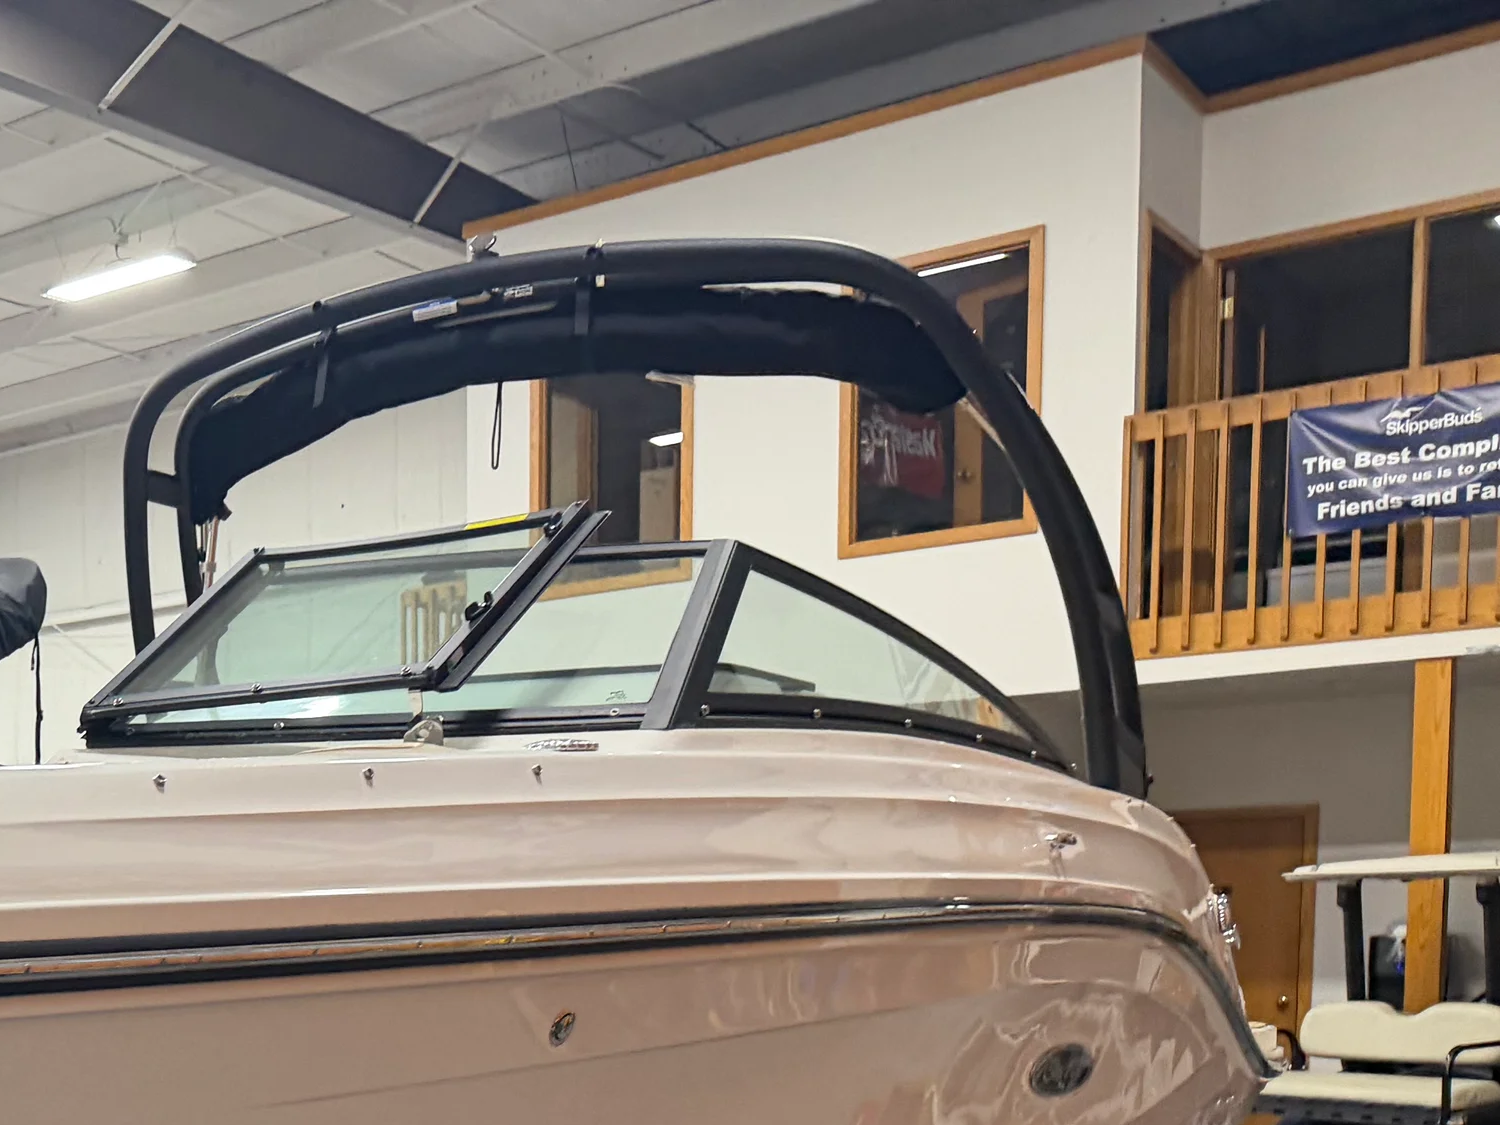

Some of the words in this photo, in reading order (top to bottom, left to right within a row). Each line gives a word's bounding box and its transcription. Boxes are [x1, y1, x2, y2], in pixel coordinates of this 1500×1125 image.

[1303, 455, 1347, 475] The
[1354, 446, 1412, 469] Best
[1419, 433, 1500, 462] Compl
[1307, 481, 1335, 498] you
[1338, 477, 1368, 490] can
[1372, 472, 1408, 489] give
[1412, 470, 1433, 482] us
[1437, 466, 1452, 479] is
[1457, 464, 1475, 477] to
[1317, 493, 1404, 521] Friends
[1411, 486, 1458, 508] and
[1466, 483, 1500, 503] Fa
